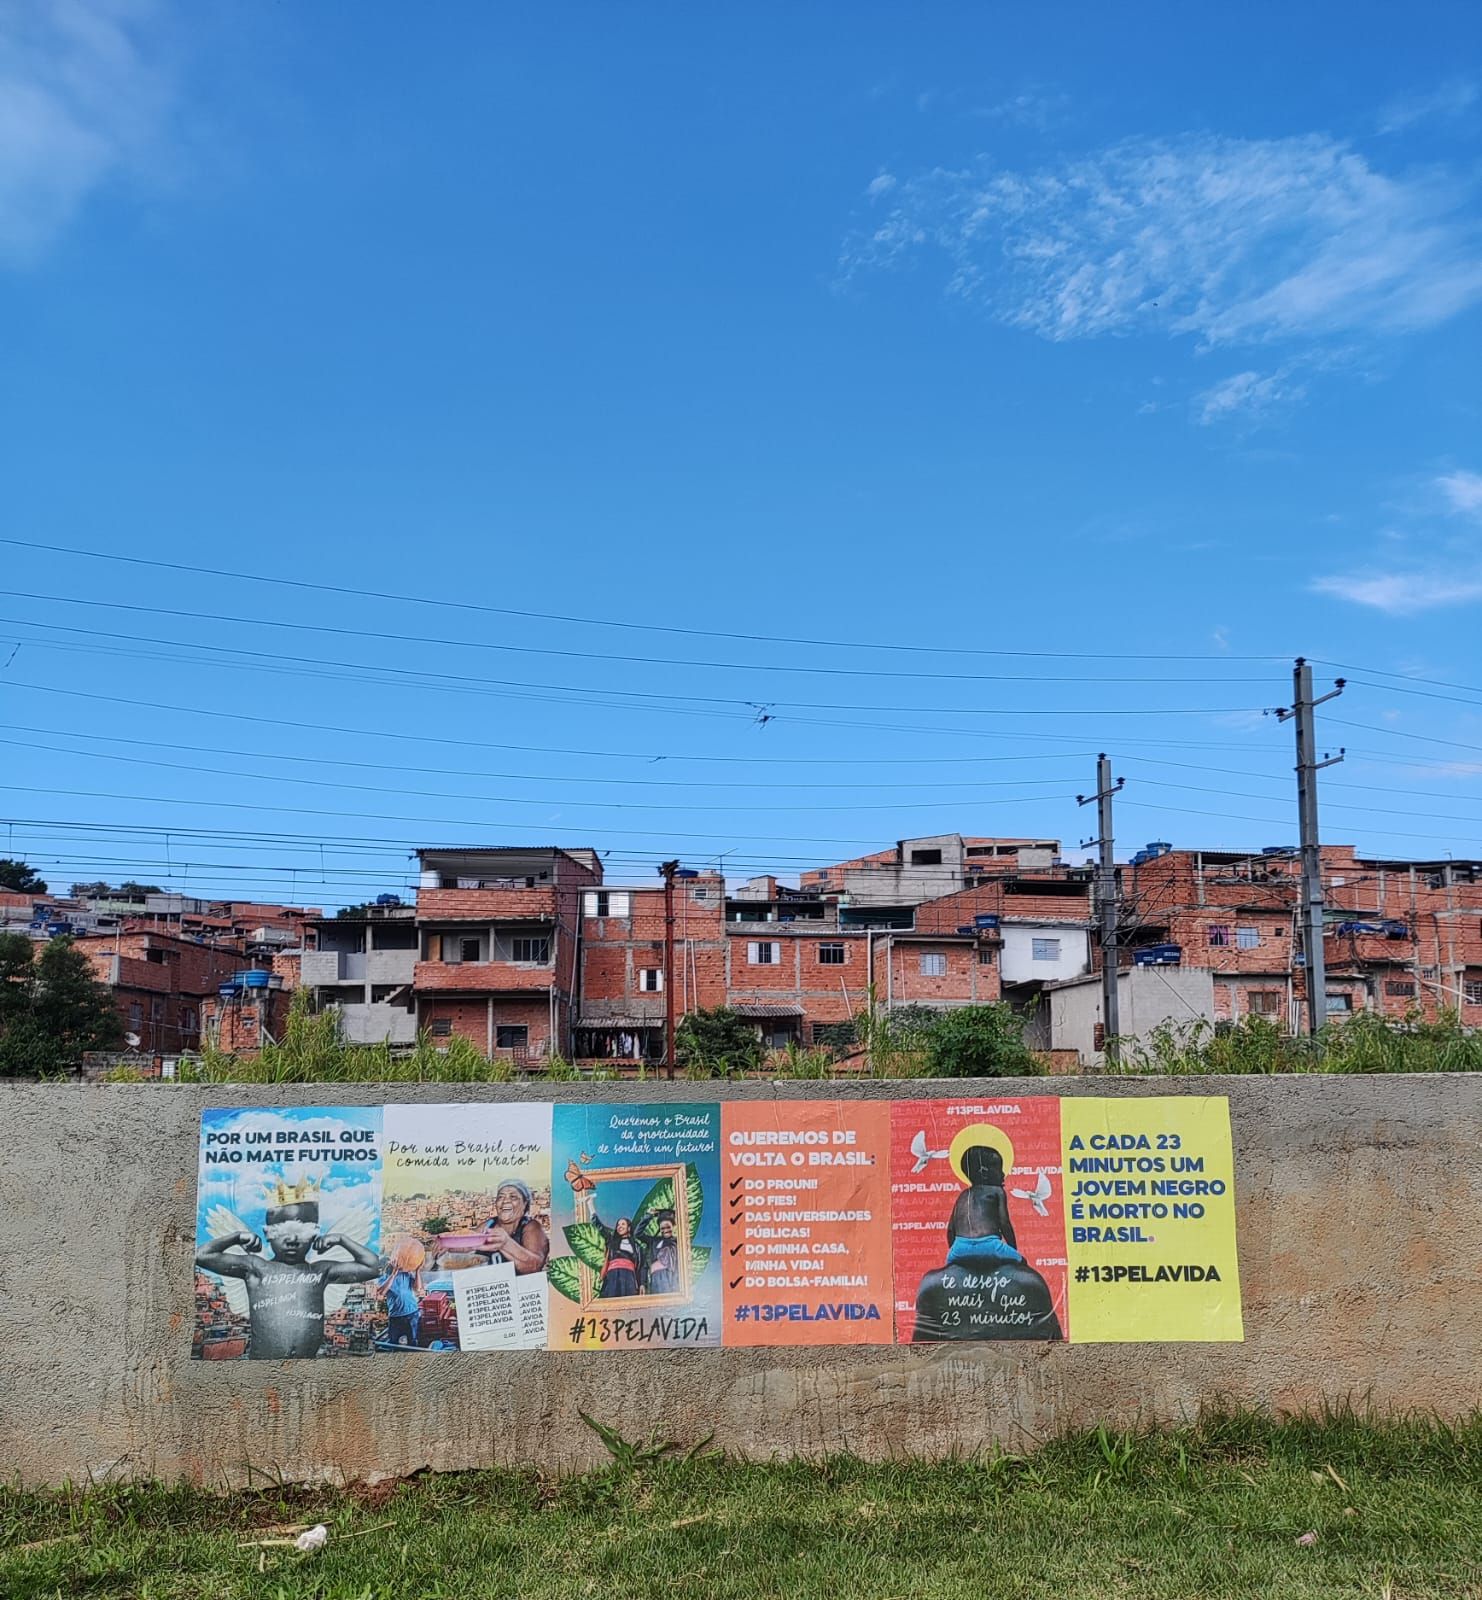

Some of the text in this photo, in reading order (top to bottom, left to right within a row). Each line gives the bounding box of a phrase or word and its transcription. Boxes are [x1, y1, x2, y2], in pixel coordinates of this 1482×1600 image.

[946, 1104, 1022, 1115] #13PELAVIDA
[608, 1113, 710, 1129] Queremos o Brasil
[206, 1130, 375, 1145] POR UM BRASIL QUE
[621, 1128, 710, 1143] da oportunidade
[729, 1130, 857, 1146] QUEREMOS DE
[1069, 1134, 1181, 1151] A CADA 23
[388, 1139, 541, 1155] Por um Brasil com
[597, 1140, 714, 1157] de sonhar um futuro!
[205, 1148, 378, 1164] NÃO MATE FUTUROS
[396, 1154, 530, 1172] comida no prato!
[729, 1151, 876, 1166] VOLTA O BRASIL:
[1009, 1166, 1064, 1175] 3PELAVIDA
[1069, 1157, 1166, 1174] MINUTOS
[1170, 1156, 1204, 1173] UM
[745, 1178, 818, 1190] DO PROUNI!
[891, 1183, 962, 1193] #13PELAVIDA
[1071, 1179, 1226, 1197] JOVEM NEGRO
[745, 1195, 797, 1206] DO FIES!
[745, 1210, 872, 1222] DAS UNIVERSIDADES
[1071, 1198, 1085, 1220] É
[1088, 1203, 1169, 1220] MORTO
[1172, 1202, 1205, 1219] NO
[745, 1225, 811, 1239] PÚBLICAS!
[1072, 1226, 1155, 1243] BRASIL.
[745, 1242, 849, 1255] DO MINHA CASA,
[745, 1259, 825, 1271] MINHA VIDA!
[745, 1276, 765, 1288] DO
[1074, 1265, 1222, 1283] #13PELAVIDA
[941, 1273, 957, 1289] te
[962, 1270, 1011, 1303] desejo
[948, 1292, 1026, 1312] mais que
[734, 1303, 881, 1322] #13PELAVIDA
[941, 1309, 1034, 1326] 23 minutos
[568, 1317, 709, 1344] #13PELAVIDA
